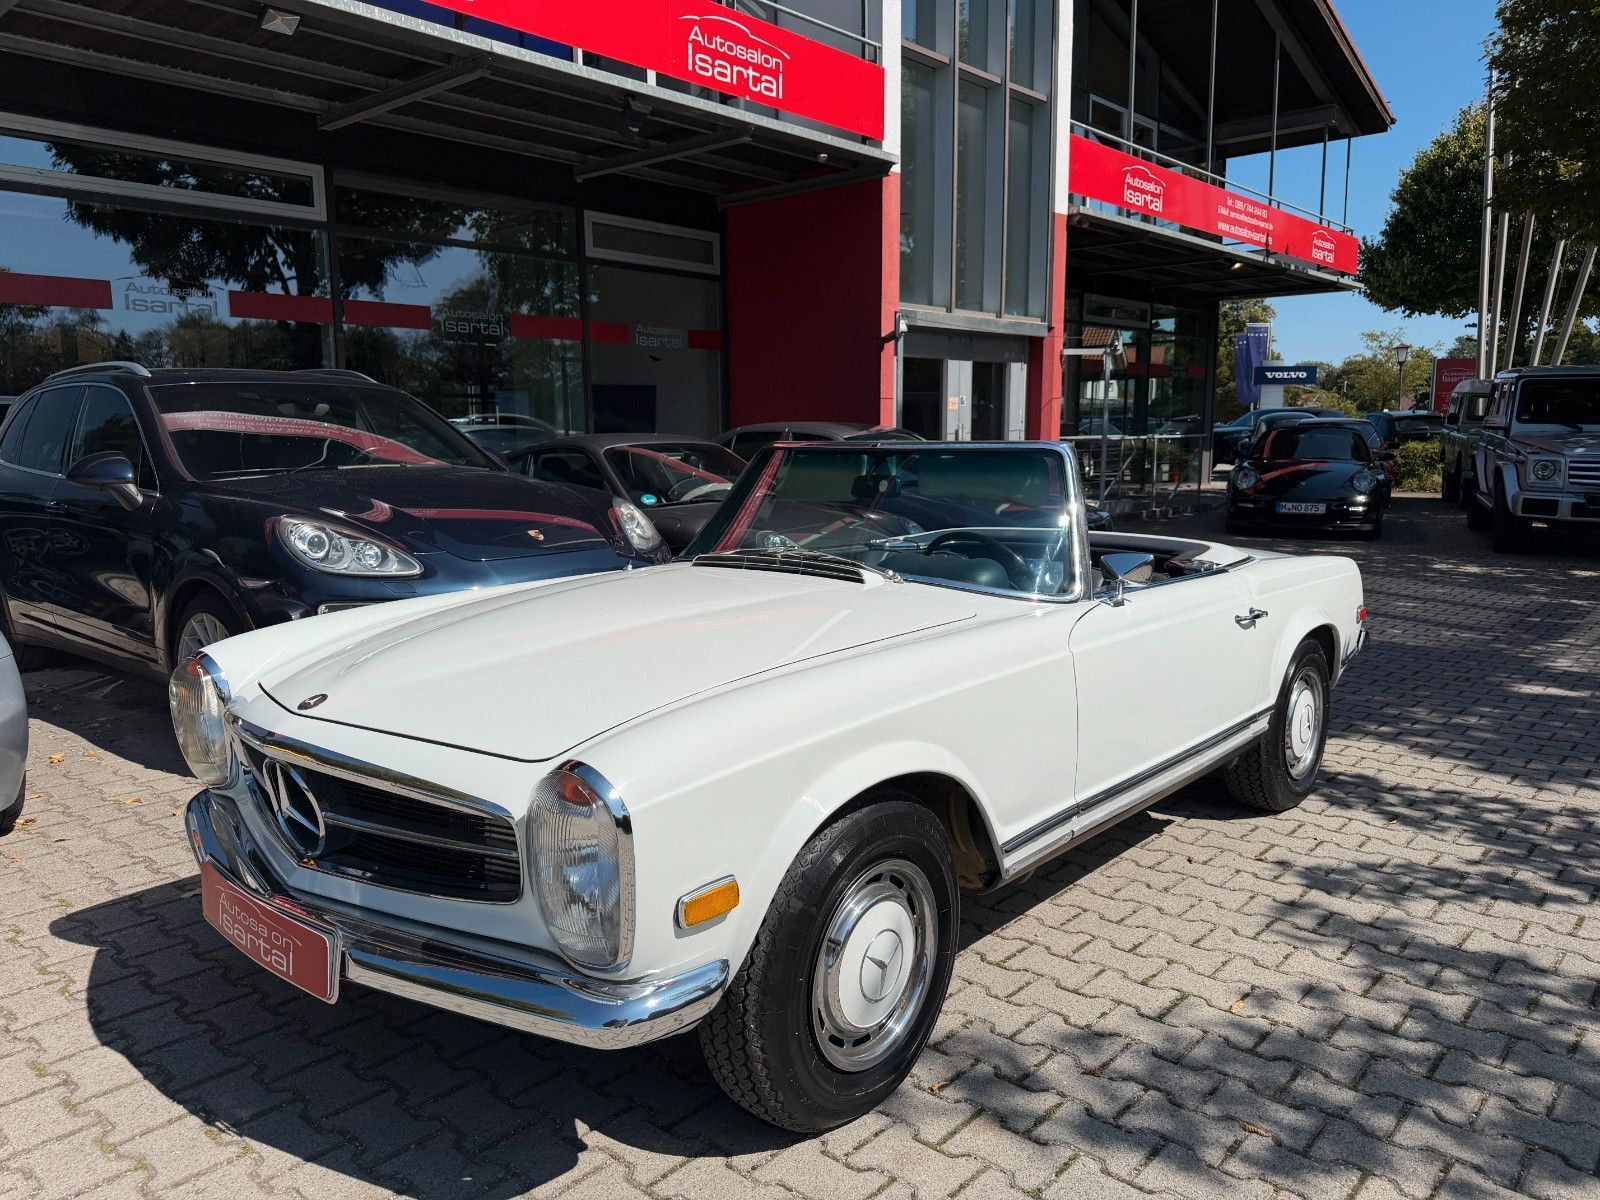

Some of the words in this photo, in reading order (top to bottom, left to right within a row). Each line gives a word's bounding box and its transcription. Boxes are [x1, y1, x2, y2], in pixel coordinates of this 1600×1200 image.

[688, 25, 783, 73] Autosalon
[687, 41, 783, 100] Isartal
[1125, 173, 1163, 195] Autosalon
[1123, 183, 1163, 212] Isartal
[1312, 243, 1335, 264] Isartal
[442, 307, 503, 320] Autosalon
[441, 319, 504, 336] Isartal
[635, 332, 683, 348] Isartal
[1264, 371, 1307, 379] VOLVO
[1303, 504, 1320, 512] 875
[219, 901, 293, 976] Isartal
